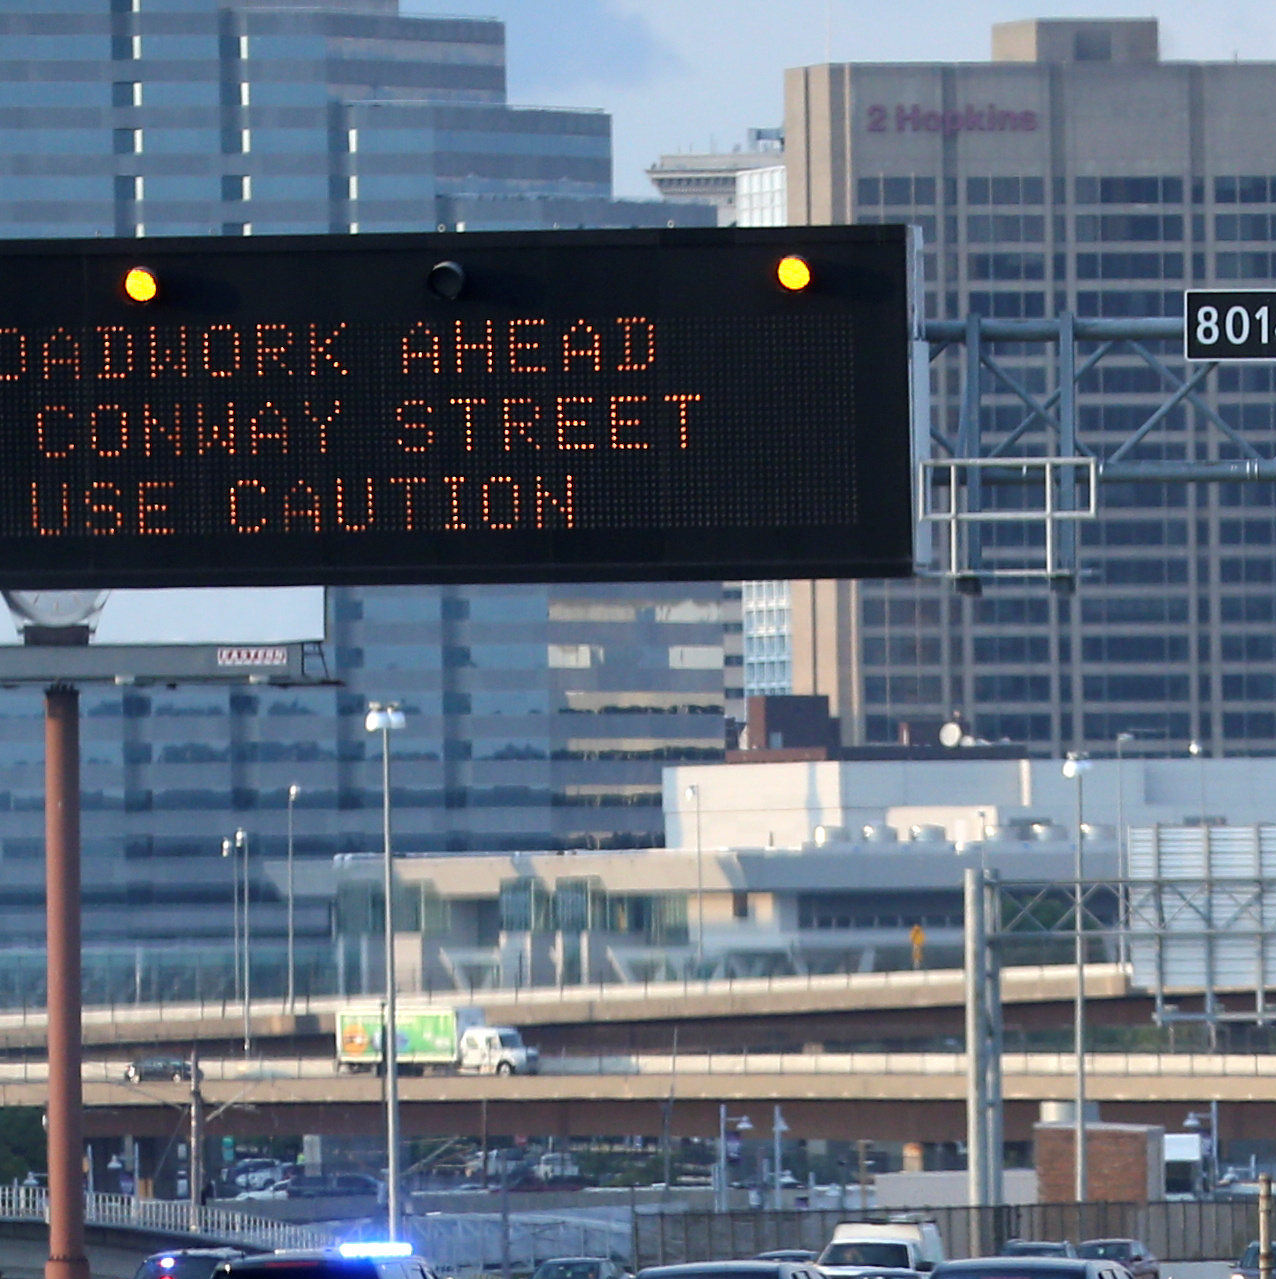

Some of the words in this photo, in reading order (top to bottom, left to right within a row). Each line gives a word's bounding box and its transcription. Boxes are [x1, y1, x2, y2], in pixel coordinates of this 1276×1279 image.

[866, 103, 888, 133] 2
[895, 102, 1039, 137] Hopkins
[402, 316, 656, 374] AHEAD
[36, 400, 342, 459] CONWAY
[396, 392, 702, 452] STREET
[31, 480, 176, 535] USE
[229, 473, 575, 534] CAUTION
